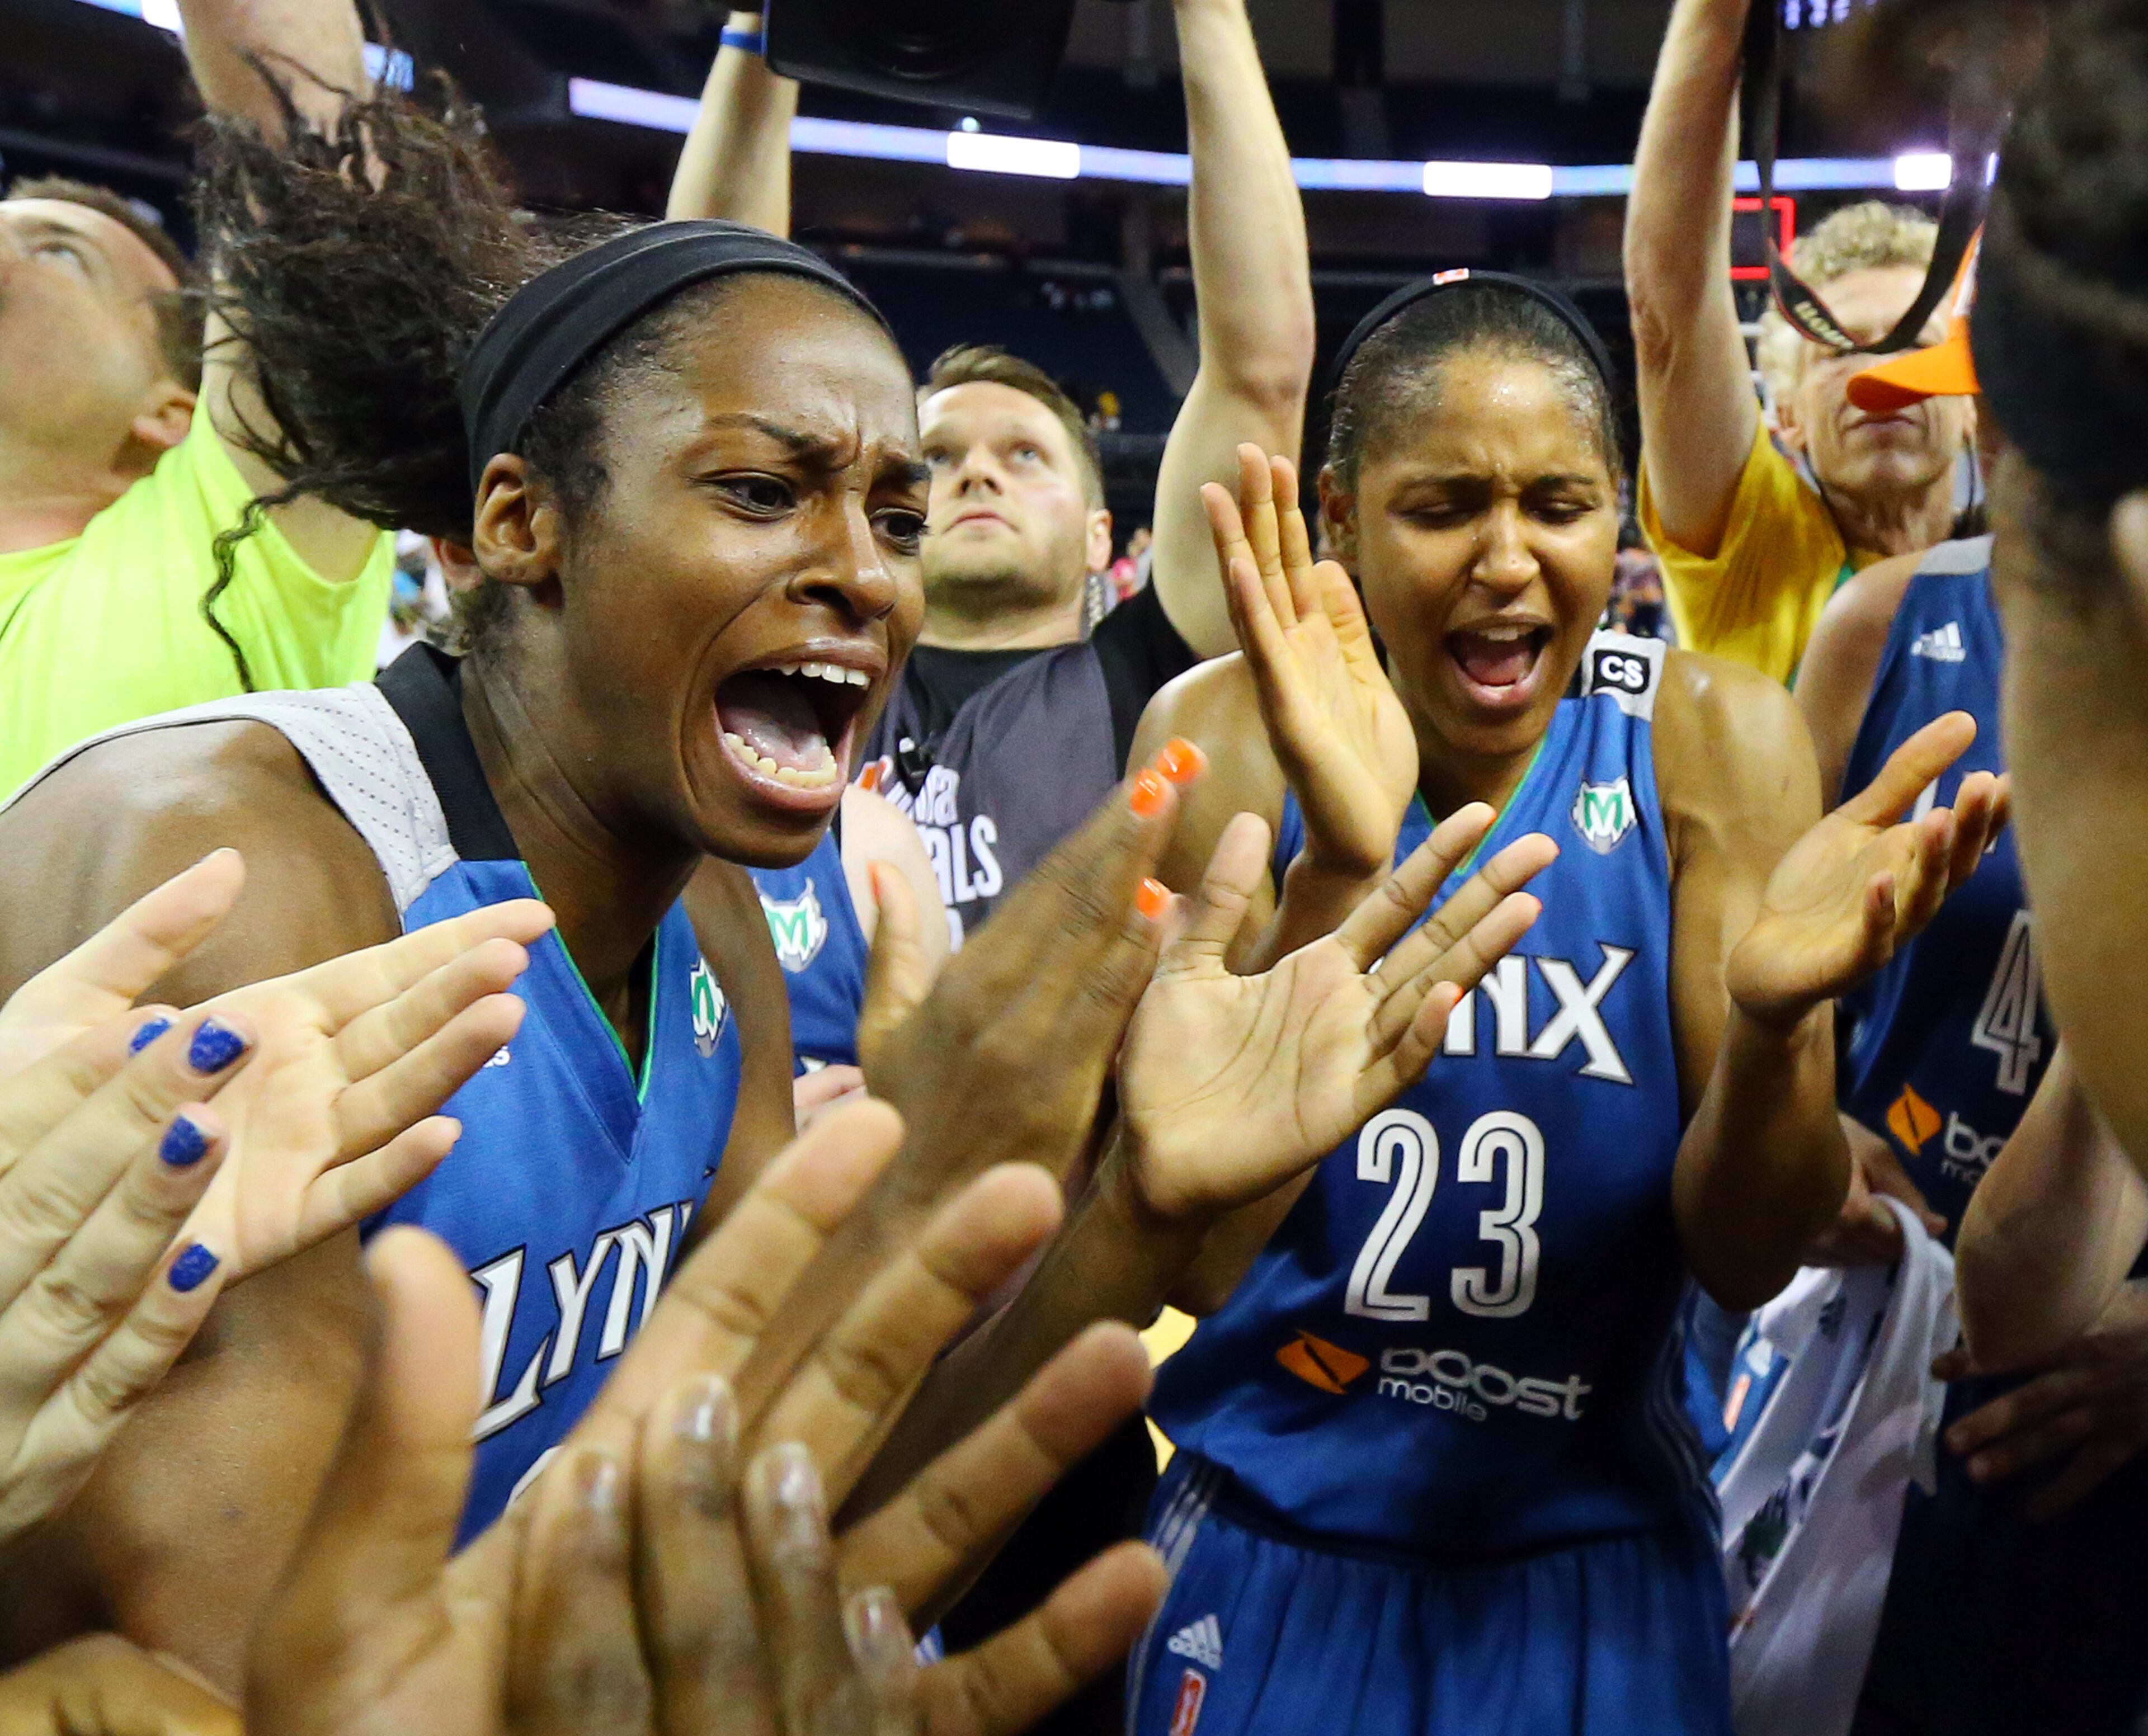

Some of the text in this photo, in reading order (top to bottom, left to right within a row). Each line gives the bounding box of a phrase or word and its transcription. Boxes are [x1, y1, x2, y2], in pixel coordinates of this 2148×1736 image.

[1600, 655, 1645, 688] CS
[1584, 791, 1622, 830] M
[1443, 942, 1635, 1086] NX
[1972, 909, 2040, 1095] 4
[1344, 1108, 1545, 1321] 23
[468, 1198, 694, 1443] LYN
[1378, 1376, 1487, 1421] mobile
